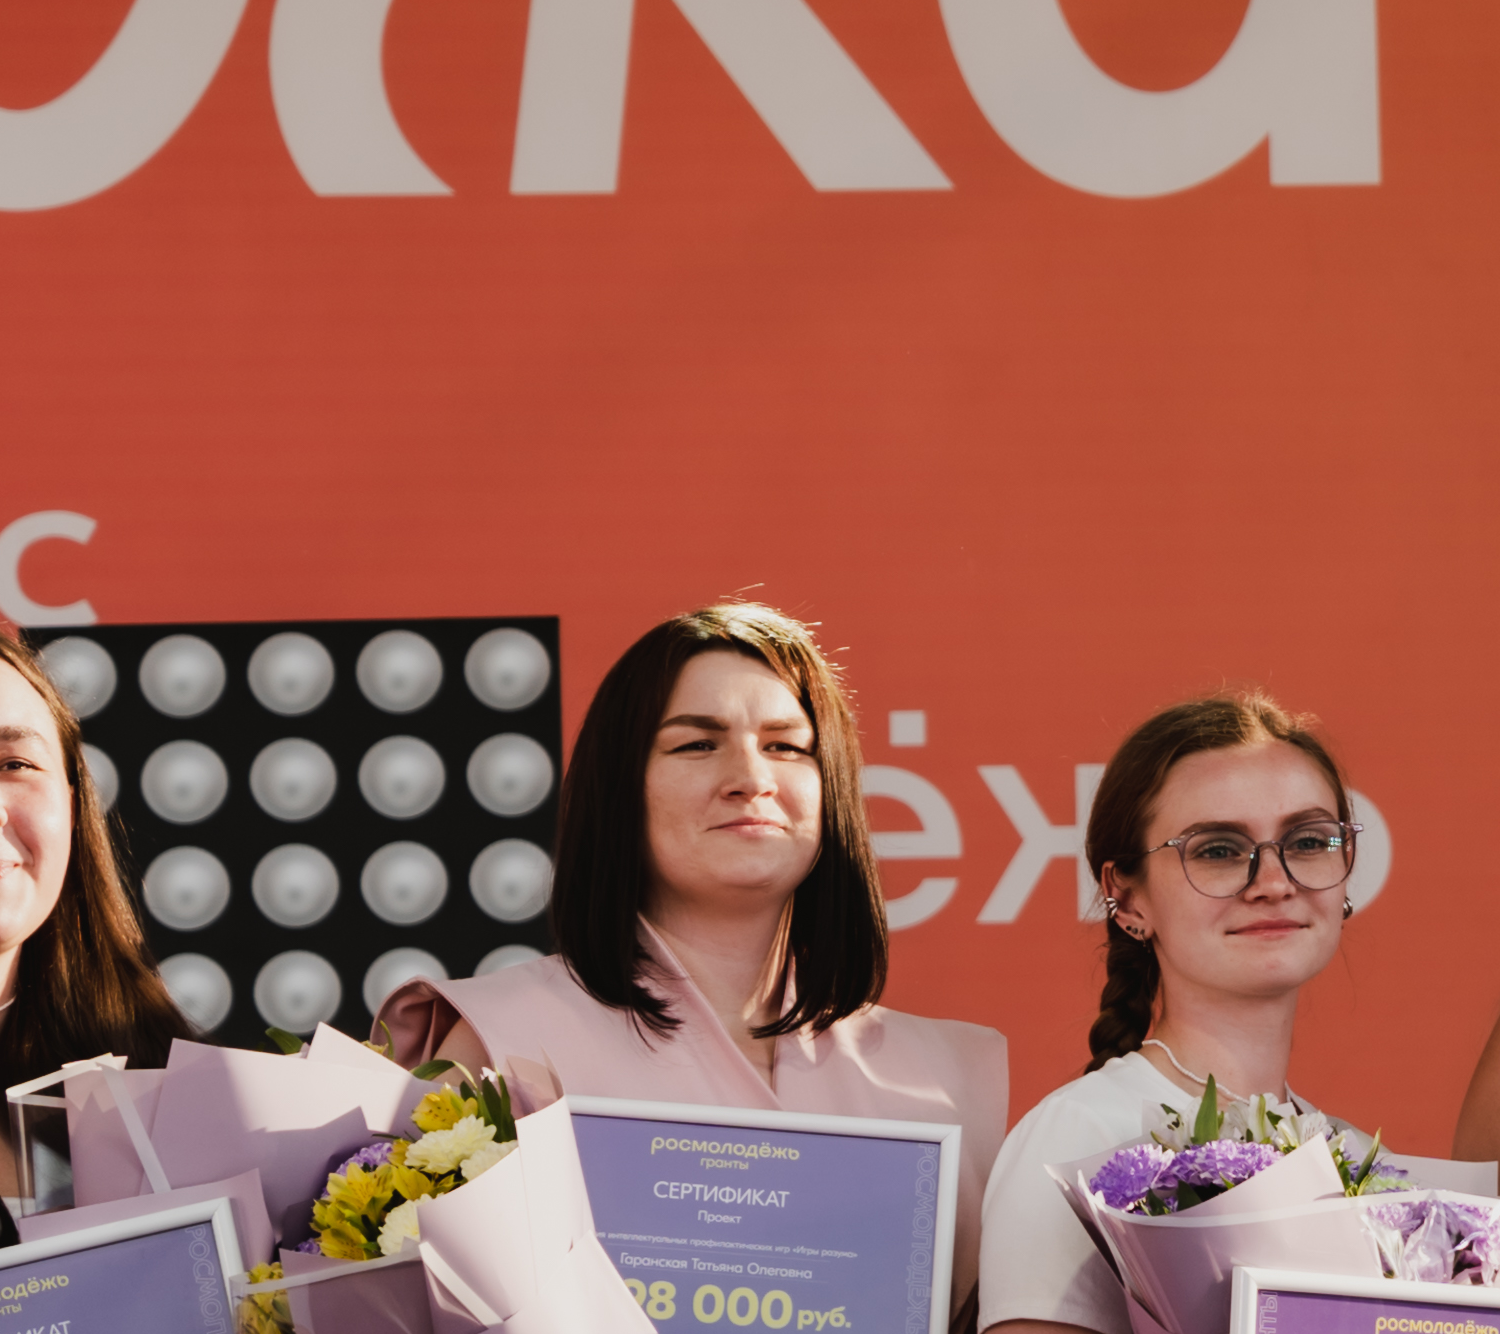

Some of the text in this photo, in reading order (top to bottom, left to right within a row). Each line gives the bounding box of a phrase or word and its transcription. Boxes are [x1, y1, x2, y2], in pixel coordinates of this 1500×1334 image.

[650, 1136, 800, 1161] росмолодёжь
[653, 1180, 791, 1208] СЕРТИФИКАТ
[623, 1278, 677, 1321] 98
[692, 1283, 794, 1330] 000
